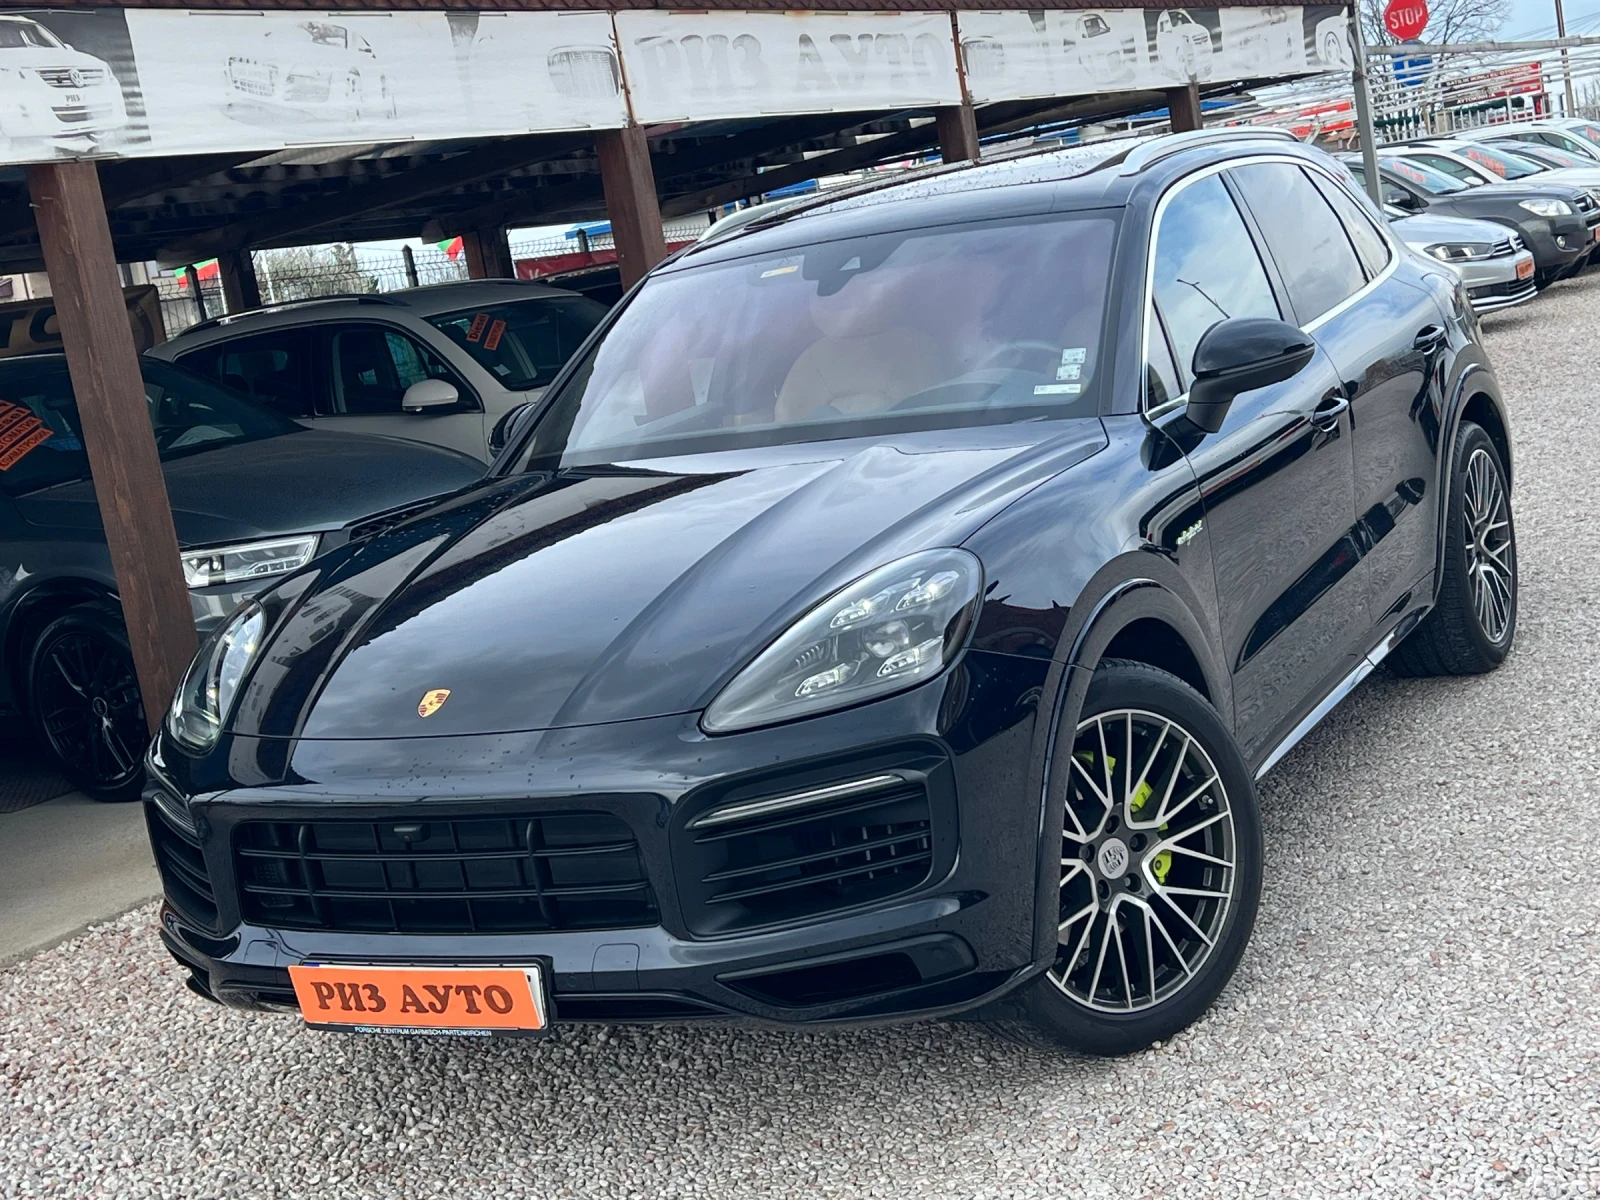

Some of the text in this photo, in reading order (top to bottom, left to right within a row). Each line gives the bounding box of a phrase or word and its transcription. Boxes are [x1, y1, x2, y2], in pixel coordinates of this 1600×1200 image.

[1390, 5, 1423, 29] STOP
[634, 33, 946, 101] РИЗ АУТО
[469, 314, 488, 340] Diesel
[310, 981, 514, 1015] РИЗ АУТО
[354, 1026, 382, 1034] PORSCHE
[382, 1027, 410, 1035] ZENTRUM
